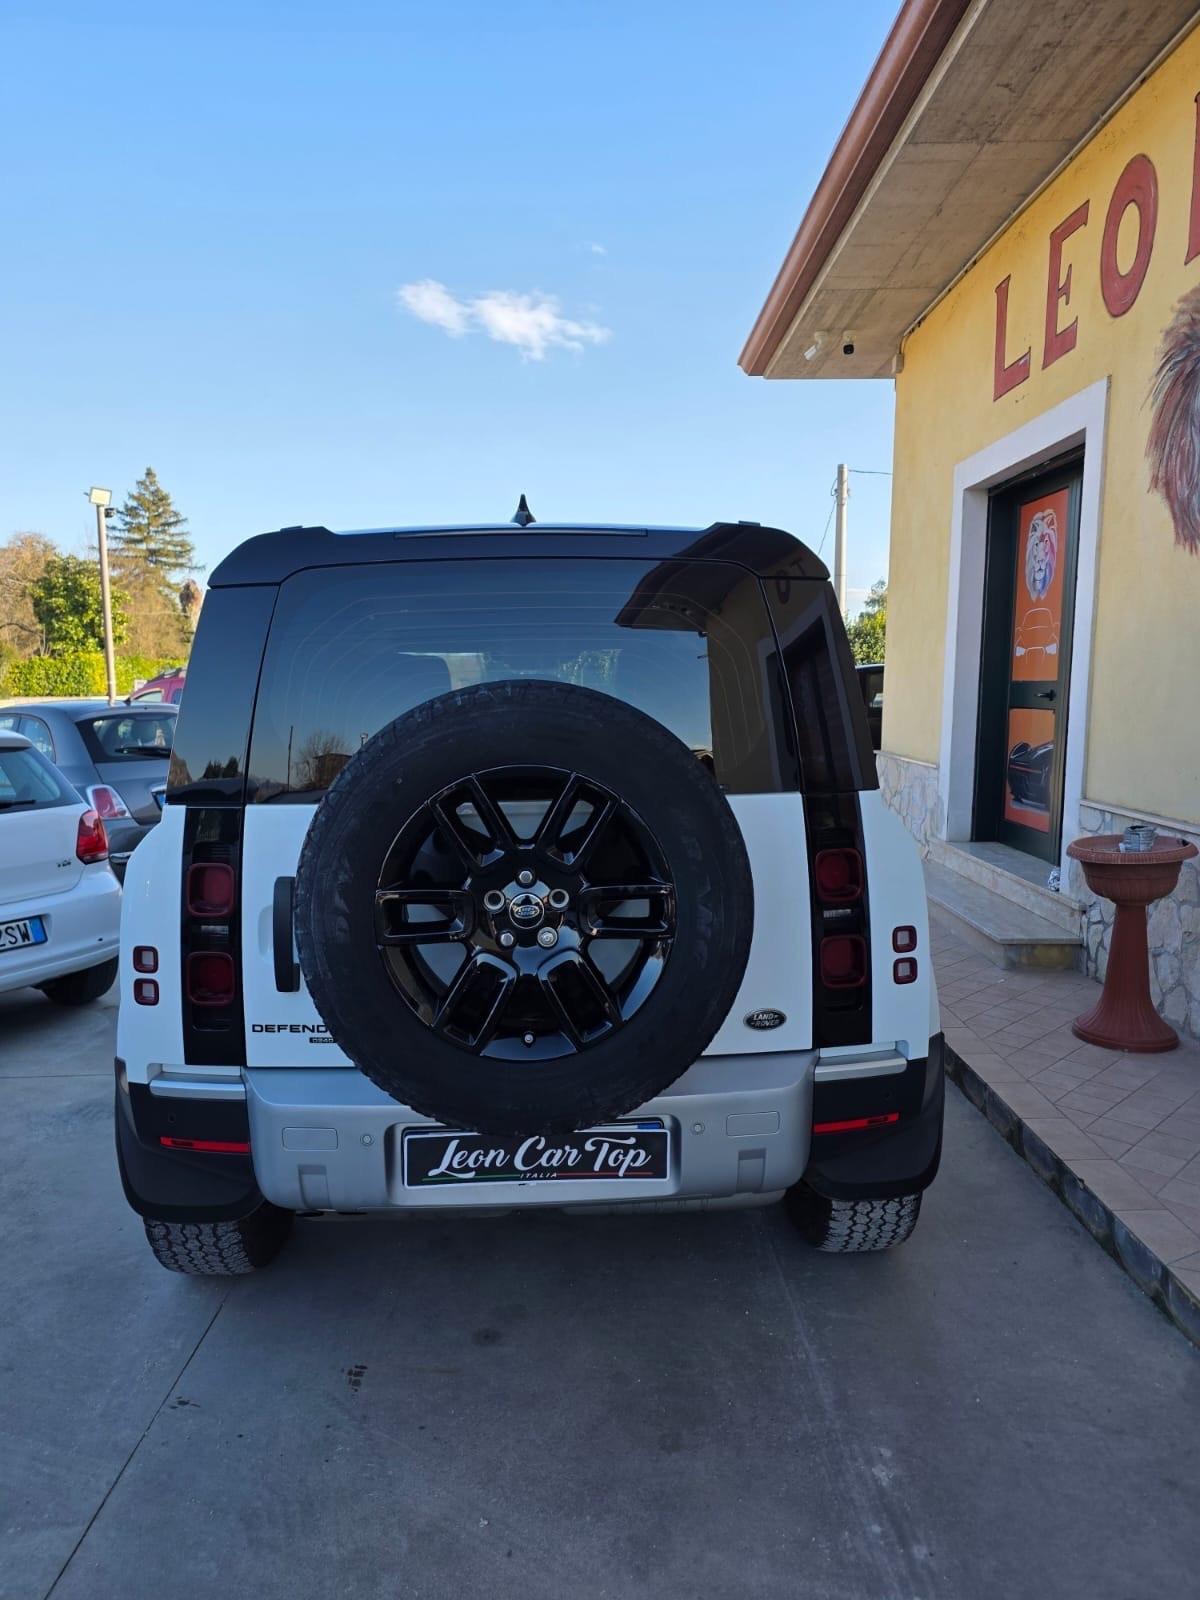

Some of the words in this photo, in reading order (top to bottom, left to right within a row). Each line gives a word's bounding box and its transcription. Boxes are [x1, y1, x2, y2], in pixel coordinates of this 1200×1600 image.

[993, 91, 1200, 402] LEO
[427, 1139, 510, 1178] Leon
[513, 1135, 582, 1171] Car
[585, 1136, 651, 1177] Top
